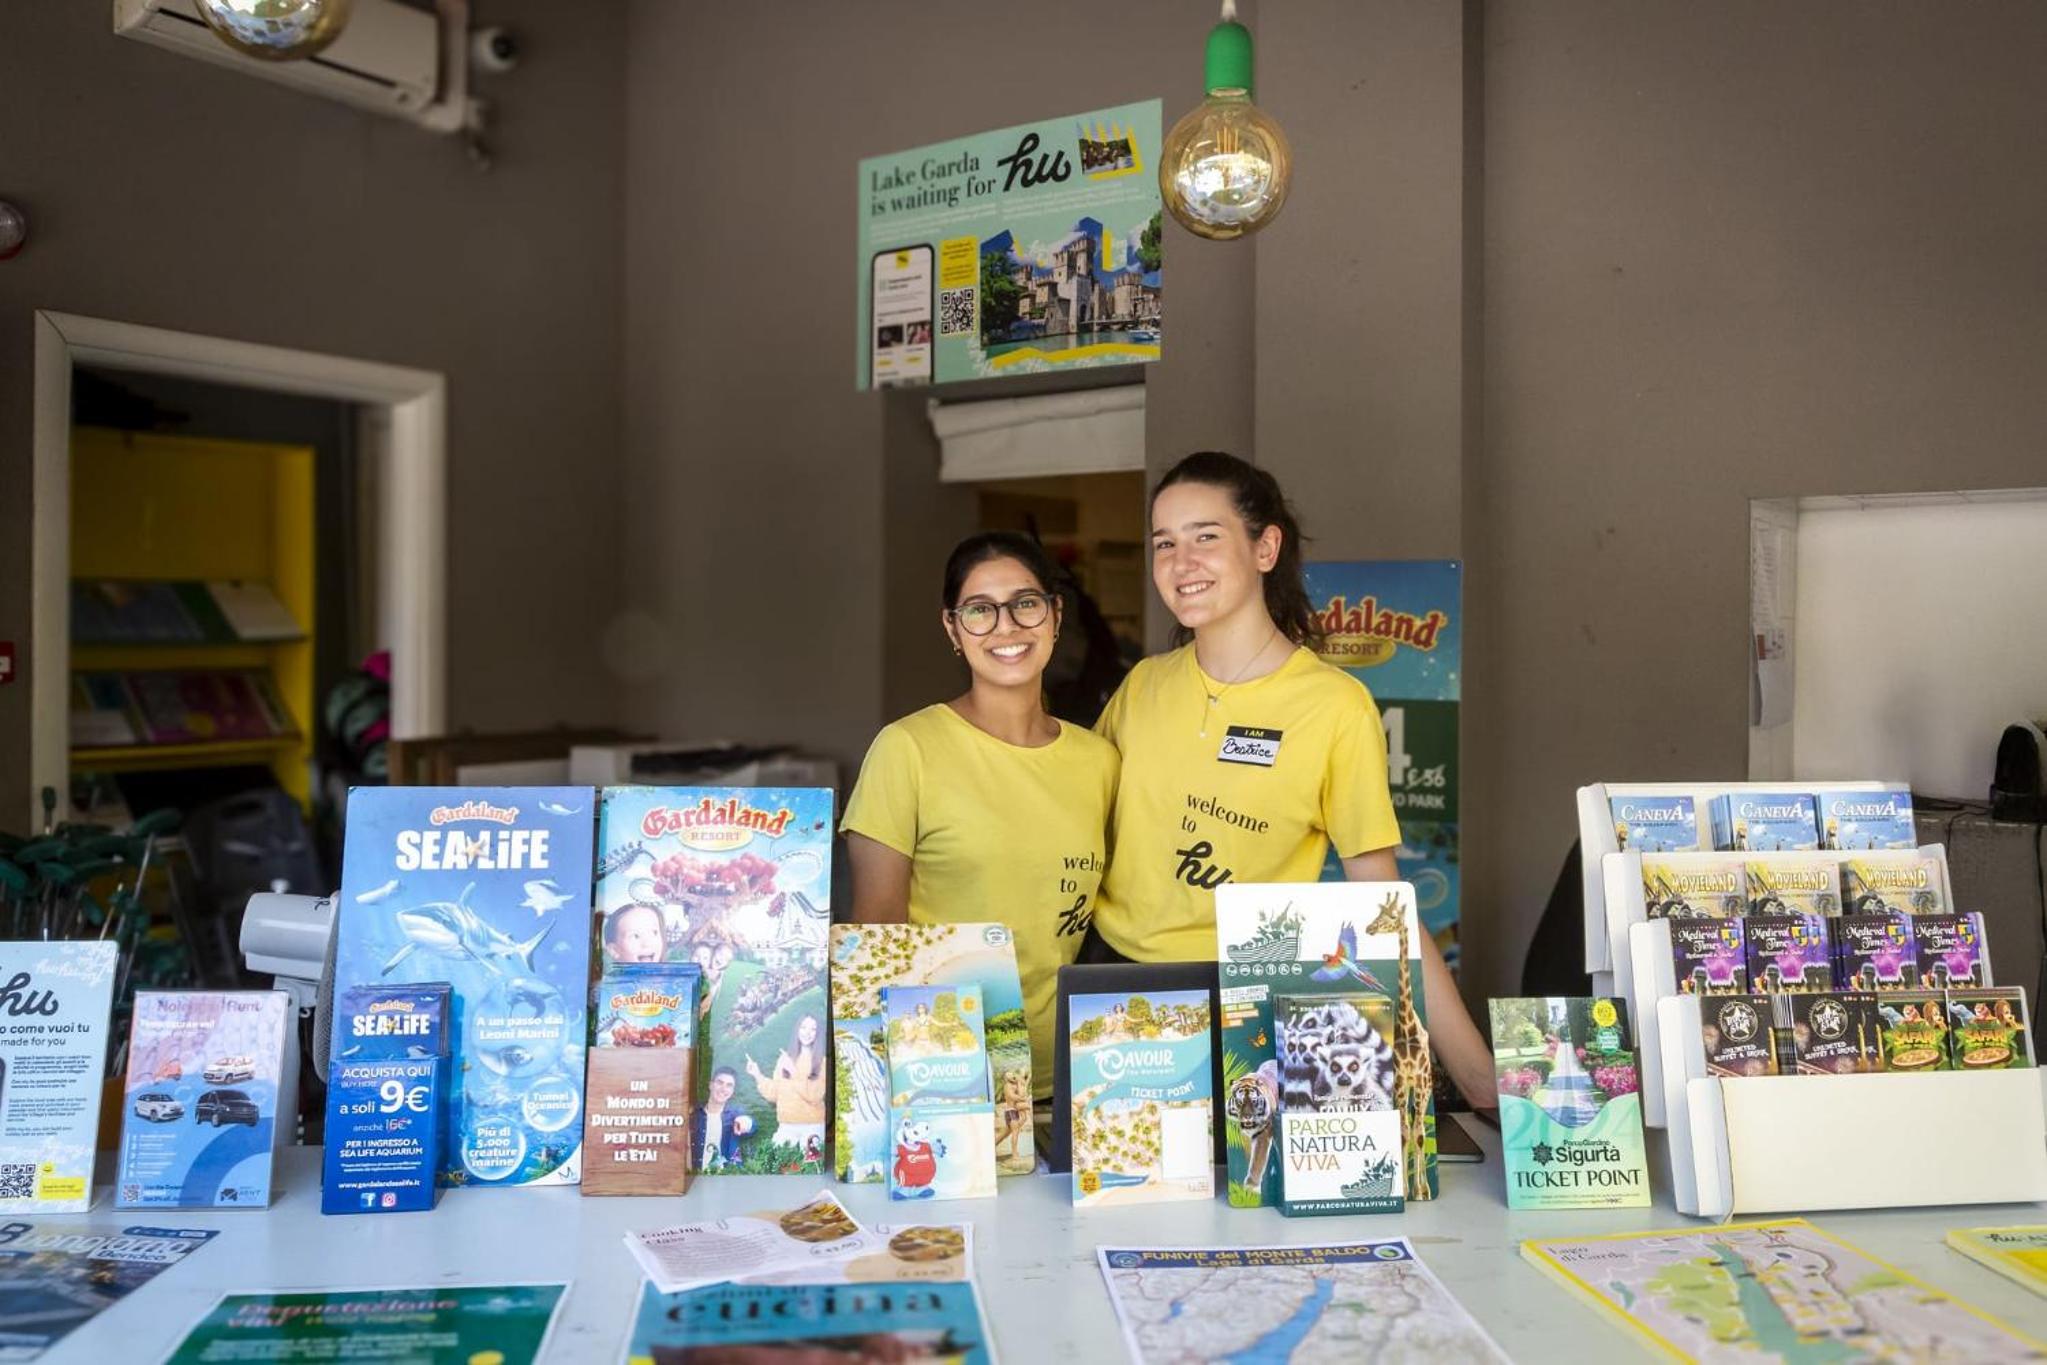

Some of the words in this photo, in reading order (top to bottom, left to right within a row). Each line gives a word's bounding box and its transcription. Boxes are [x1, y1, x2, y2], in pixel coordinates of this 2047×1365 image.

[997, 132, 1071, 192] hu
[871, 165, 916, 192] Lake
[921, 151, 980, 181] Garda
[871, 196, 885, 216] is
[891, 184, 960, 212] waiting
[967, 176, 996, 197] for
[1319, 642, 1382, 656] RESORT
[1223, 738, 1273, 758] Beatrice
[1408, 793, 1446, 809] PARK
[430, 801, 519, 825] Gardaland
[642, 797, 792, 839] Gardaland
[1187, 793, 1269, 834] welcome
[1182, 815, 1197, 833] to
[690, 831, 741, 842] RESORT
[396, 830, 468, 870] SEA
[1060, 879, 1077, 893] to
[1672, 872, 1736, 893] MOVIELAND
[1768, 871, 1829, 891] MOVIELAND
[1867, 869, 1927, 890] MOVIELAND
[1679, 928, 1718, 943] Medieval
[1751, 926, 1790, 941] Medieval
[1846, 925, 1885, 940] Medieval
[1916, 925, 1955, 940] Medieval
[0, 972, 59, 1016] hu
[611, 991, 682, 1010] Gardaland
[10, 1025, 45, 1034] come
[48, 1022, 75, 1034] vuoi
[77, 1022, 90, 1033] tu
[353, 1014, 388, 1036] SEA
[477, 1017, 485, 1026] A
[488, 1017, 504, 1025] un
[508, 1016, 542, 1027] passo
[480, 1028, 515, 1040] Leoni
[518, 1026, 559, 1039] Marini
[31, 1037, 45, 1046] for
[47, 1038, 66, 1047] you
[343, 1067, 402, 1078] ACQUISTA
[407, 1065, 431, 1077] QUI
[631, 1080, 648, 1091] UN
[340, 1104, 349, 1114] a
[352, 1101, 375, 1113] soli
[1289, 1117, 1357, 1135] PARCO
[340, 1149, 356, 1157] SEA
[357, 1148, 375, 1156] LIFE
[376, 1146, 423, 1156] AQUARIUM
[1290, 1135, 1376, 1153] NATURA
[1290, 1154, 1341, 1171] VIVA
[1556, 1145, 1620, 1166] Sigurtà
[1515, 1170, 1583, 1187] TICKET
[1587, 1169, 1641, 1186] POINT
[1292, 1200, 1398, 1210] WWW.PARCONATURAVIVA.IT
[1143, 1252, 1208, 1260] FUNIVIE
[1215, 1250, 1238, 1259] del
[1245, 1249, 1303, 1258] MONTE
[1311, 1247, 1370, 1257] BALDO
